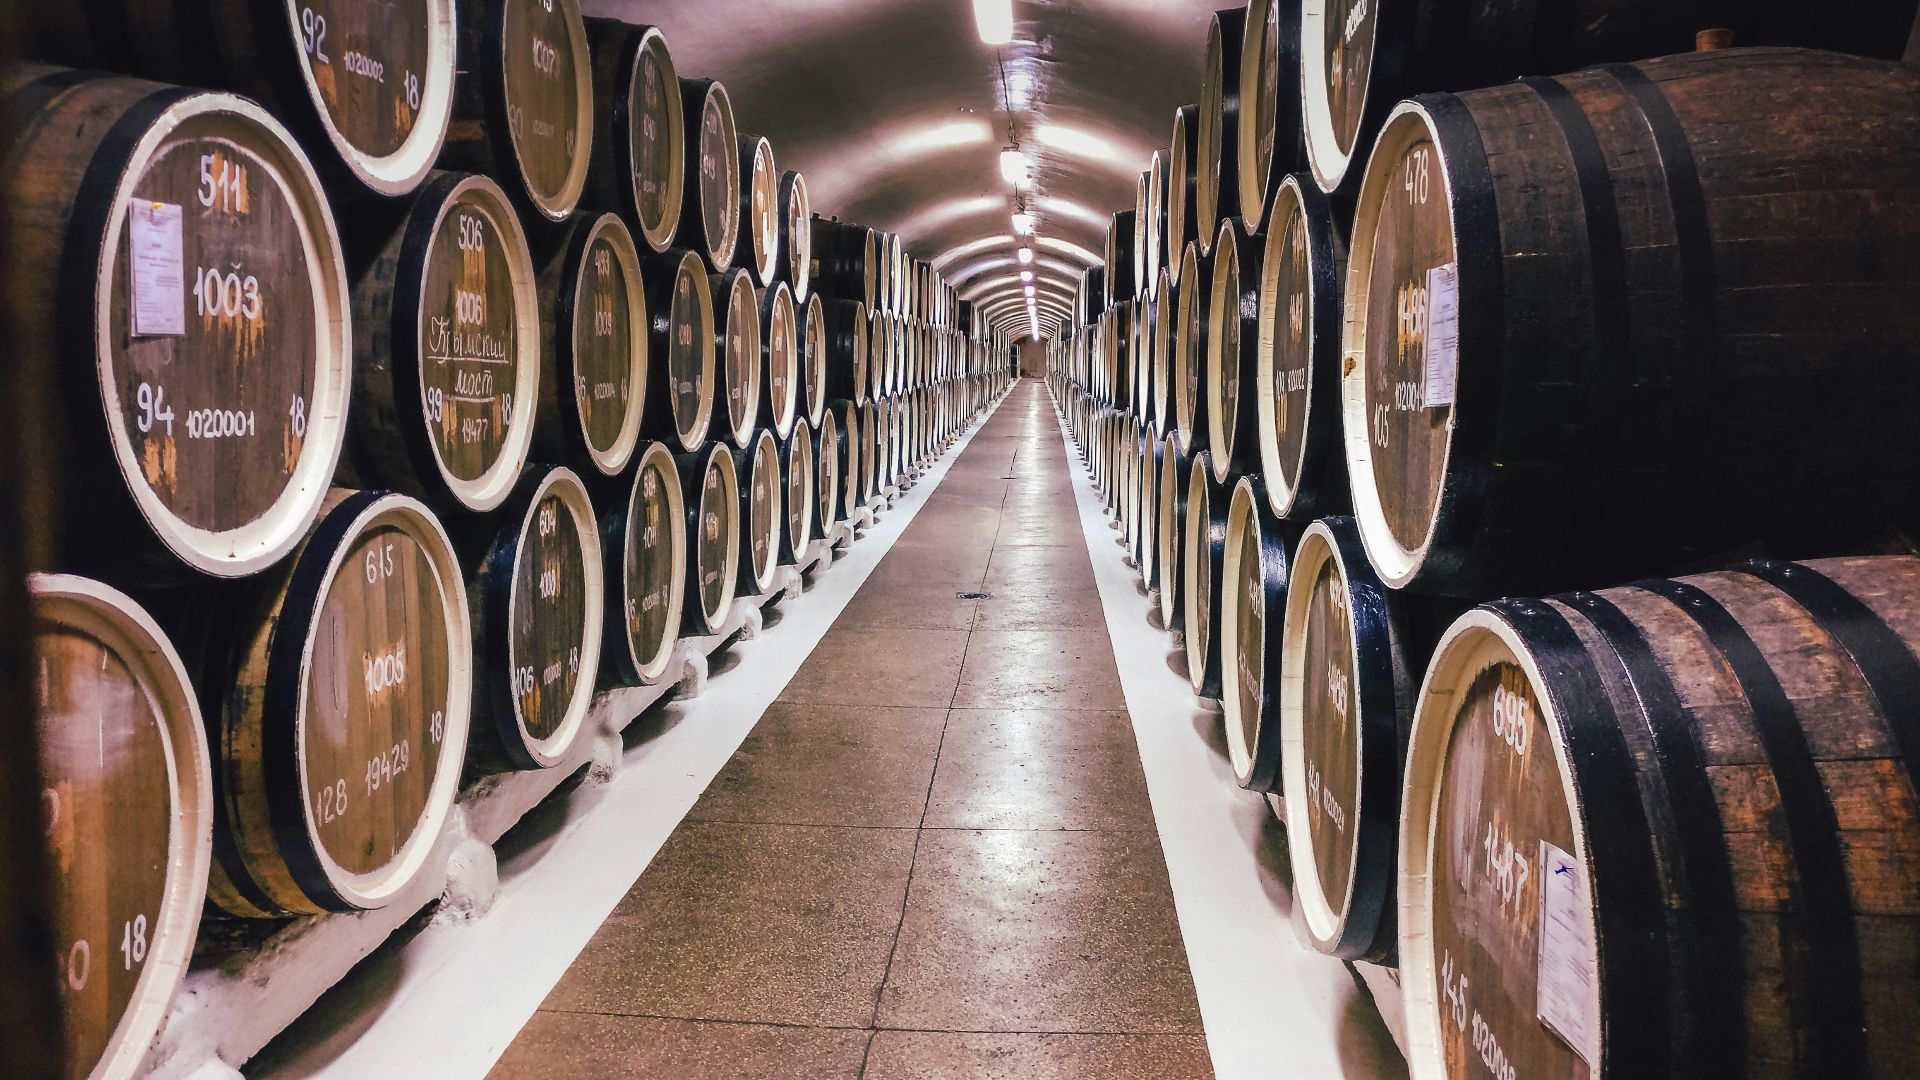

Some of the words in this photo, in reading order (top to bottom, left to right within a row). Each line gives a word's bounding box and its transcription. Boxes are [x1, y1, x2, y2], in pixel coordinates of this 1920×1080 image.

[303, 8, 329, 64] 92
[344, 51, 384, 83] 1020002
[404, 70, 419, 110] 18
[198, 154, 242, 213] 511
[1405, 148, 1429, 205] 478
[458, 214, 483, 250] 506
[193, 265, 260, 320] 1003
[455, 291, 483, 326] 1006
[595, 310, 612, 336] 1009
[137, 382, 175, 436] 94
[186, 409, 255, 439] 1020001
[289, 393, 305, 437] 18
[428, 386, 442, 422] 99
[502, 393, 511, 426] 18
[462, 418, 488, 444] 19477
[1373, 402, 1390, 449] 105
[539, 510, 556, 537] 604
[366, 543, 394, 584] 615
[515, 665, 534, 696] 106
[569, 646, 578, 673] 18
[1493, 684, 1529, 755] 695
[317, 778, 348, 829] 128
[365, 740, 410, 796] 19429
[429, 711, 442, 745] 18
[1484, 821, 1528, 911] 1487
[121, 914, 147, 970] 18
[1441, 949, 1468, 1032] 145
